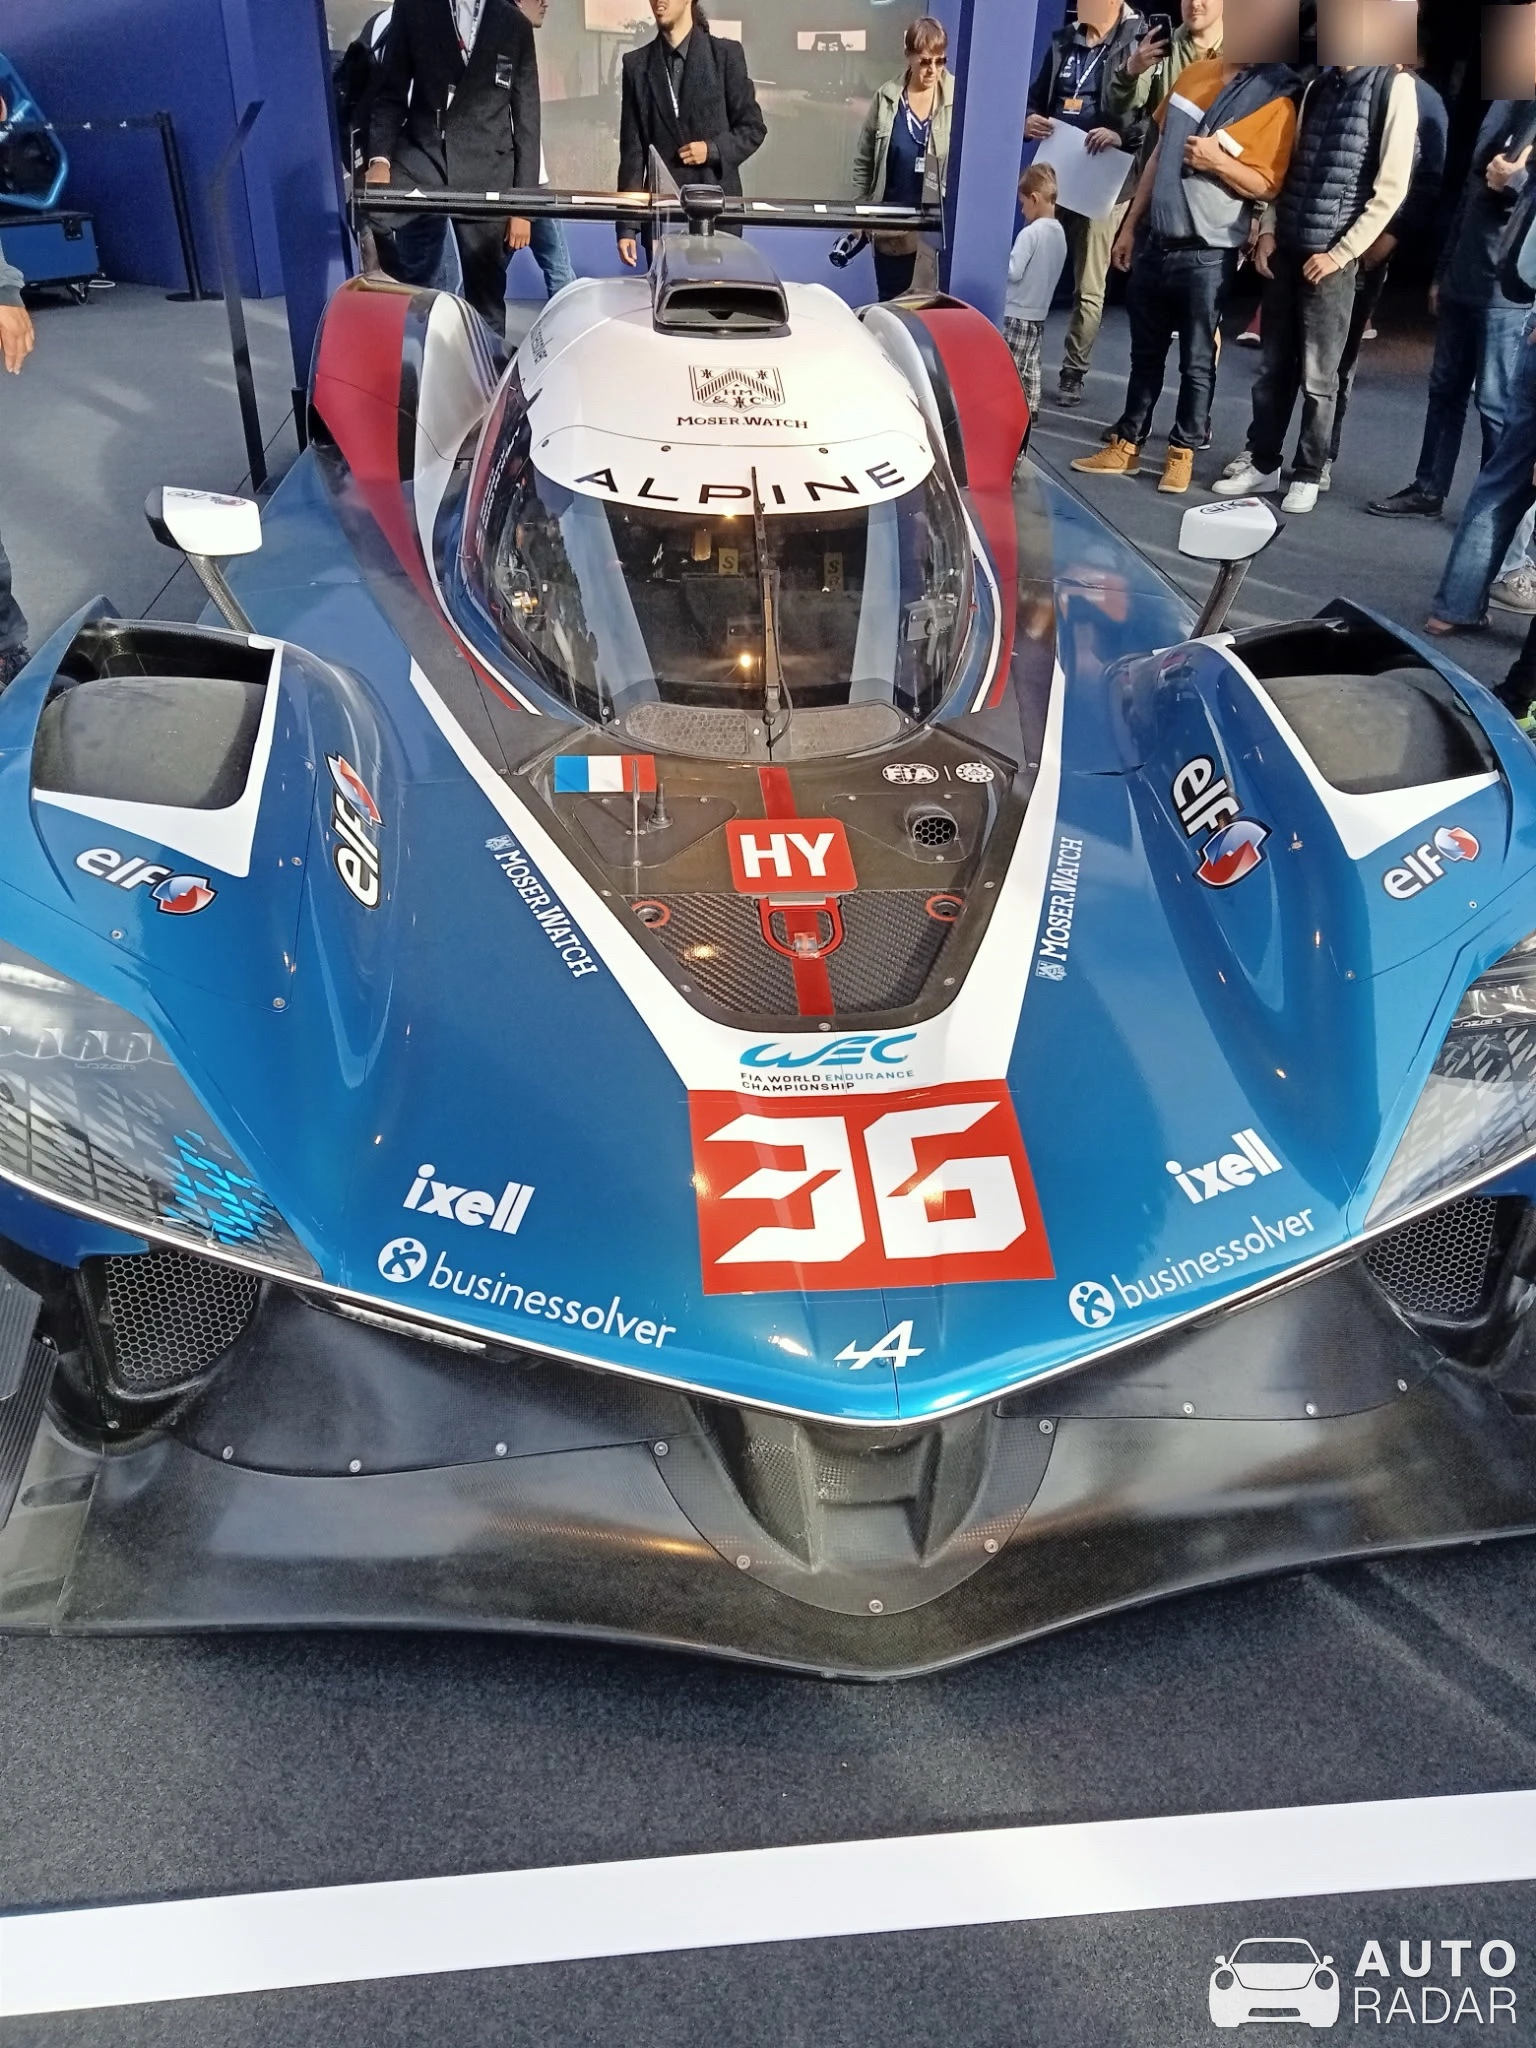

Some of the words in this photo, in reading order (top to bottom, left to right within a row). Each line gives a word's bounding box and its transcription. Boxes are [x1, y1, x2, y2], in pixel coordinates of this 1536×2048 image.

[574, 461, 905, 504] ALPINE
[1173, 757, 1240, 836] elf
[76, 848, 172, 890] elf
[334, 792, 379, 906] elf
[740, 833, 835, 878] HY
[1383, 843, 1445, 899] elf
[739, 1032, 918, 1068] WEC
[741, 1072, 763, 1082] FIA
[768, 1074, 821, 1083] WORLD
[825, 1070, 914, 1082] ENDURANCE
[742, 1081, 855, 1092] CHAMPIONSHIP
[704, 1100, 1027, 1264] 36
[1165, 1128, 1283, 1205] ixell
[402, 1163, 535, 1235] ixell
[1111, 1208, 1315, 1310] businessolver
[428, 1251, 676, 1349] businessolver
